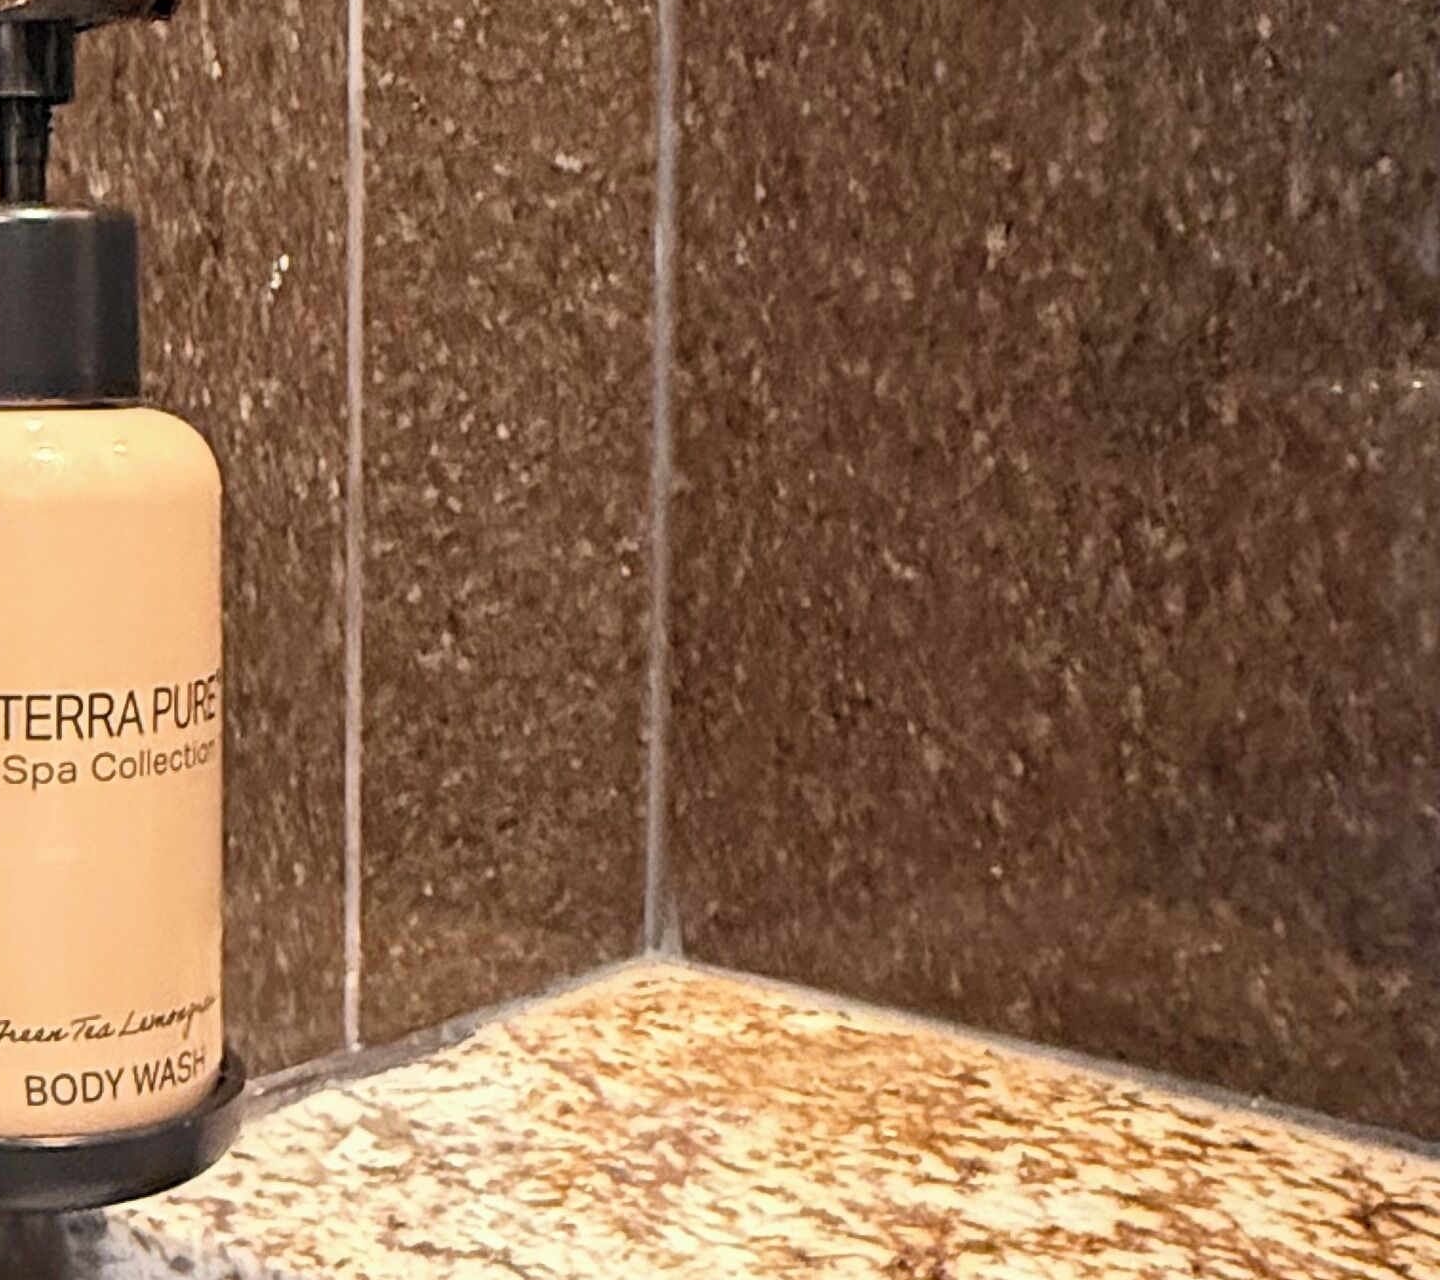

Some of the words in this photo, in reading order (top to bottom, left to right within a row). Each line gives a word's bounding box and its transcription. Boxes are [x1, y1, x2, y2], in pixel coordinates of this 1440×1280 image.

[2, 753, 77, 791] Spa
[71, 1014, 116, 1041] Tea
[24, 1066, 125, 1107] BODY
[133, 1046, 206, 1096] WASH
